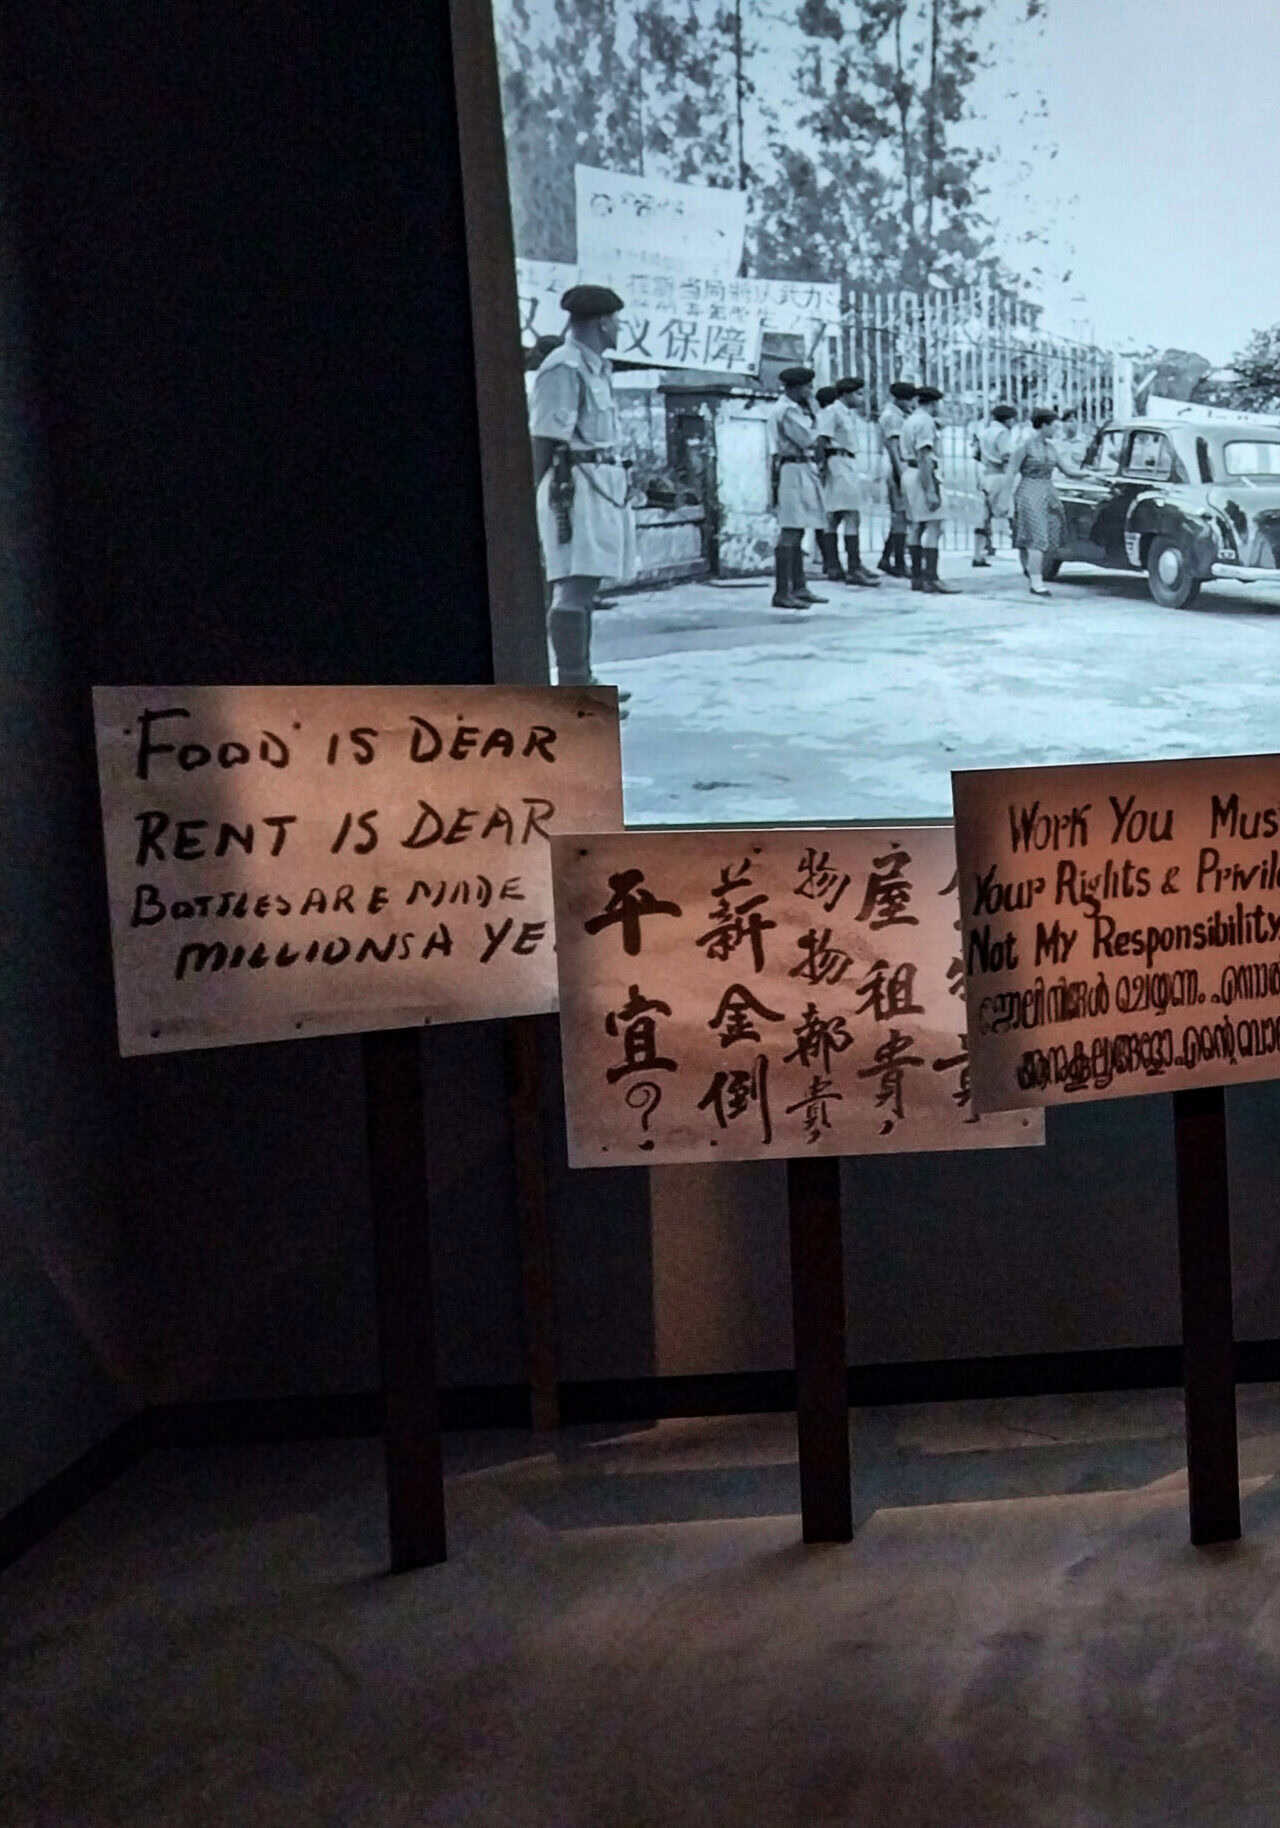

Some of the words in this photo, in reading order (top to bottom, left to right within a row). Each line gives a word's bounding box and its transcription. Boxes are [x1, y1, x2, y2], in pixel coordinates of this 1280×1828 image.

[327, 728, 380, 765] IS
[409, 714, 558, 765] DEAR
[135, 811, 297, 866] RENT
[331, 810, 379, 854] IS
[401, 798, 555, 850] DEAR
[1009, 801, 1093, 853] Work
[1109, 795, 1174, 845] You
[406, 875, 527, 909] MADE
[972, 864, 1045, 916] Your
[1055, 858, 1150, 918] Rights
[1161, 864, 1181, 896] &
[967, 924, 1019, 976] Not
[1034, 919, 1078, 967] My
